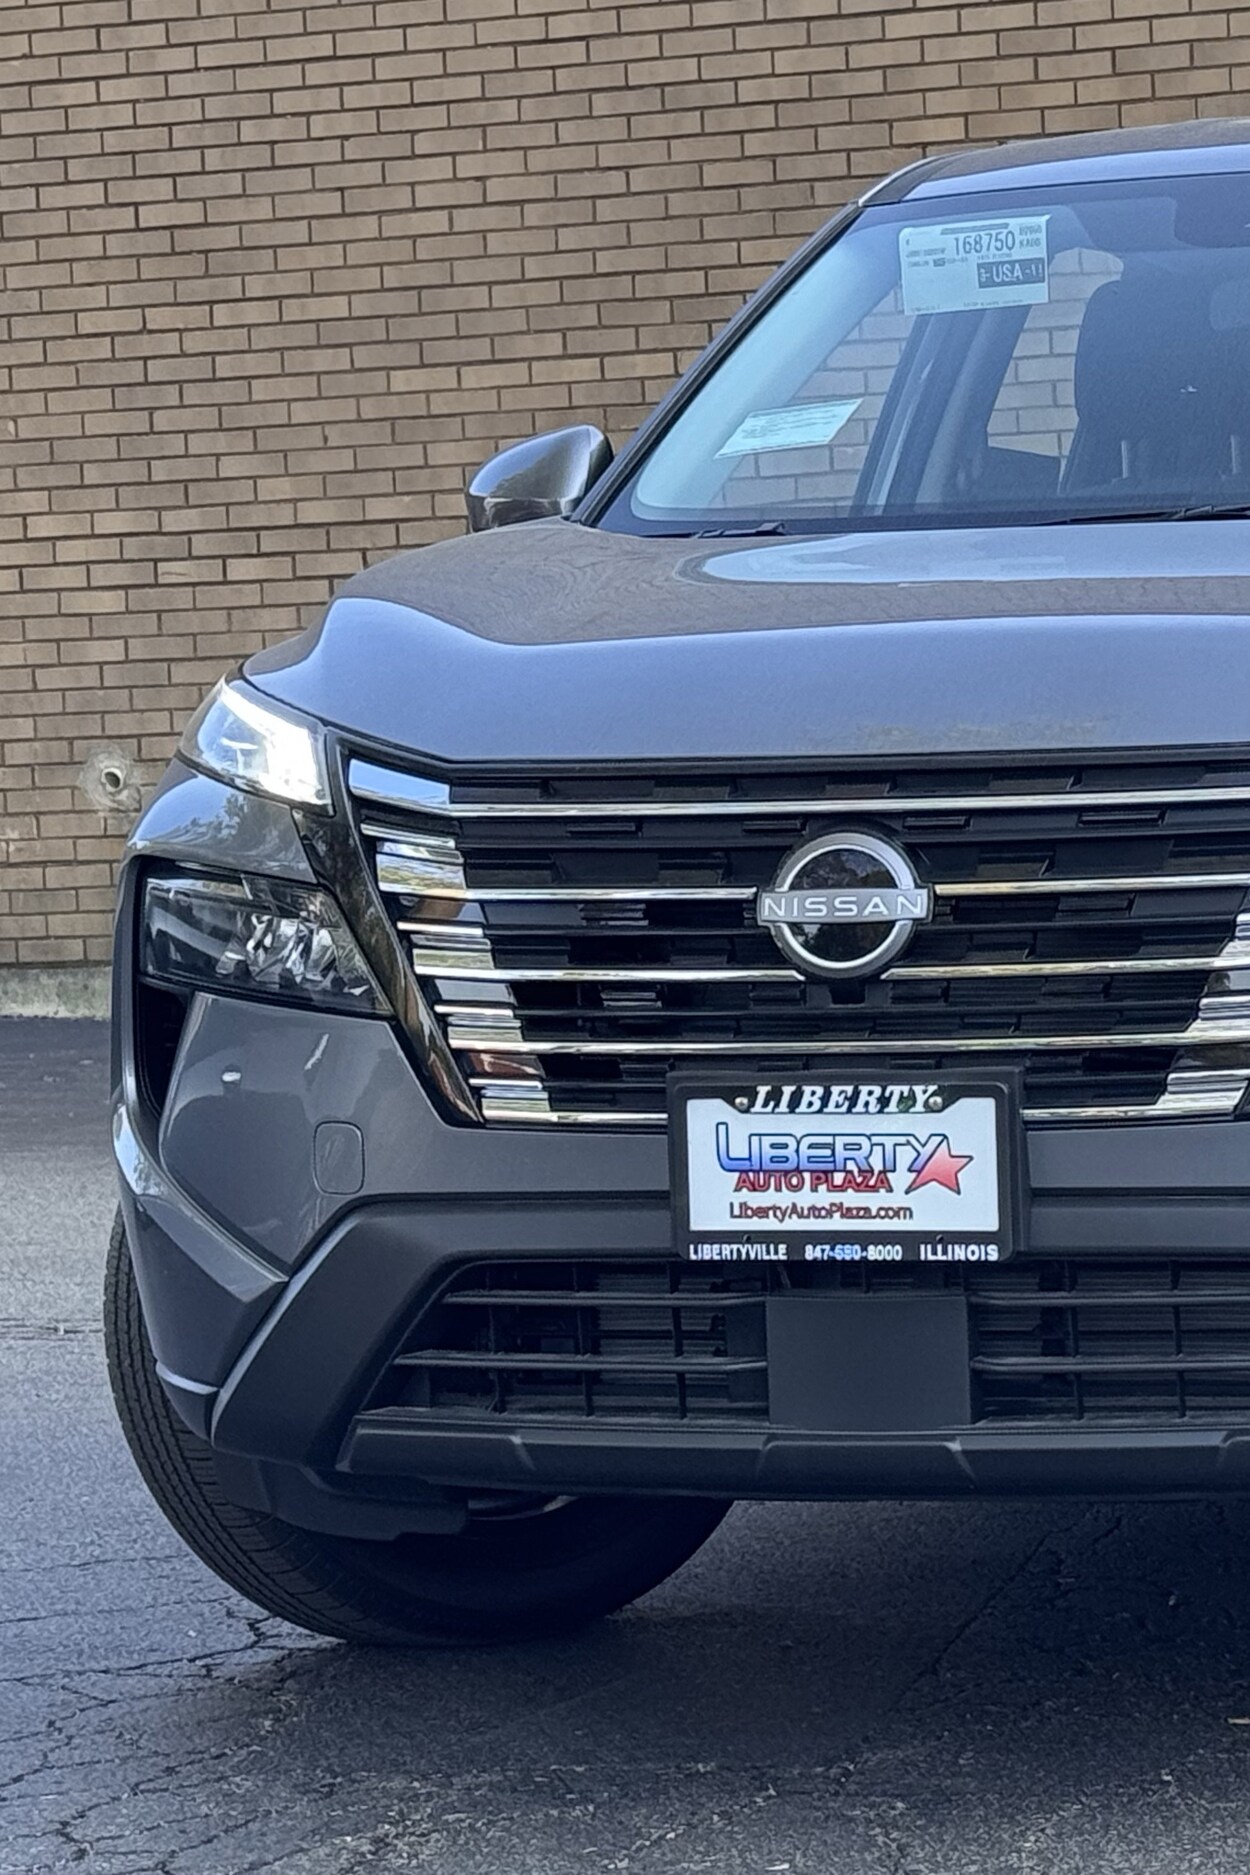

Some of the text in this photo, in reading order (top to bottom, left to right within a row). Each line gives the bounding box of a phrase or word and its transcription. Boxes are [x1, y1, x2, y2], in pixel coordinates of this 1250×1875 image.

[953, 230, 1016, 257] 168750
[763, 895, 923, 918] NISSAN
[750, 1084, 939, 1114] LIBERTY
[716, 1122, 949, 1172] LIBERTY
[733, 1171, 893, 1193] AUTO PLAZA
[729, 1201, 914, 1223] LibertyAutoPlaza.com
[689, 1243, 788, 1261] LIBERTYVILLE
[919, 1244, 999, 1262] ILLINOIS
